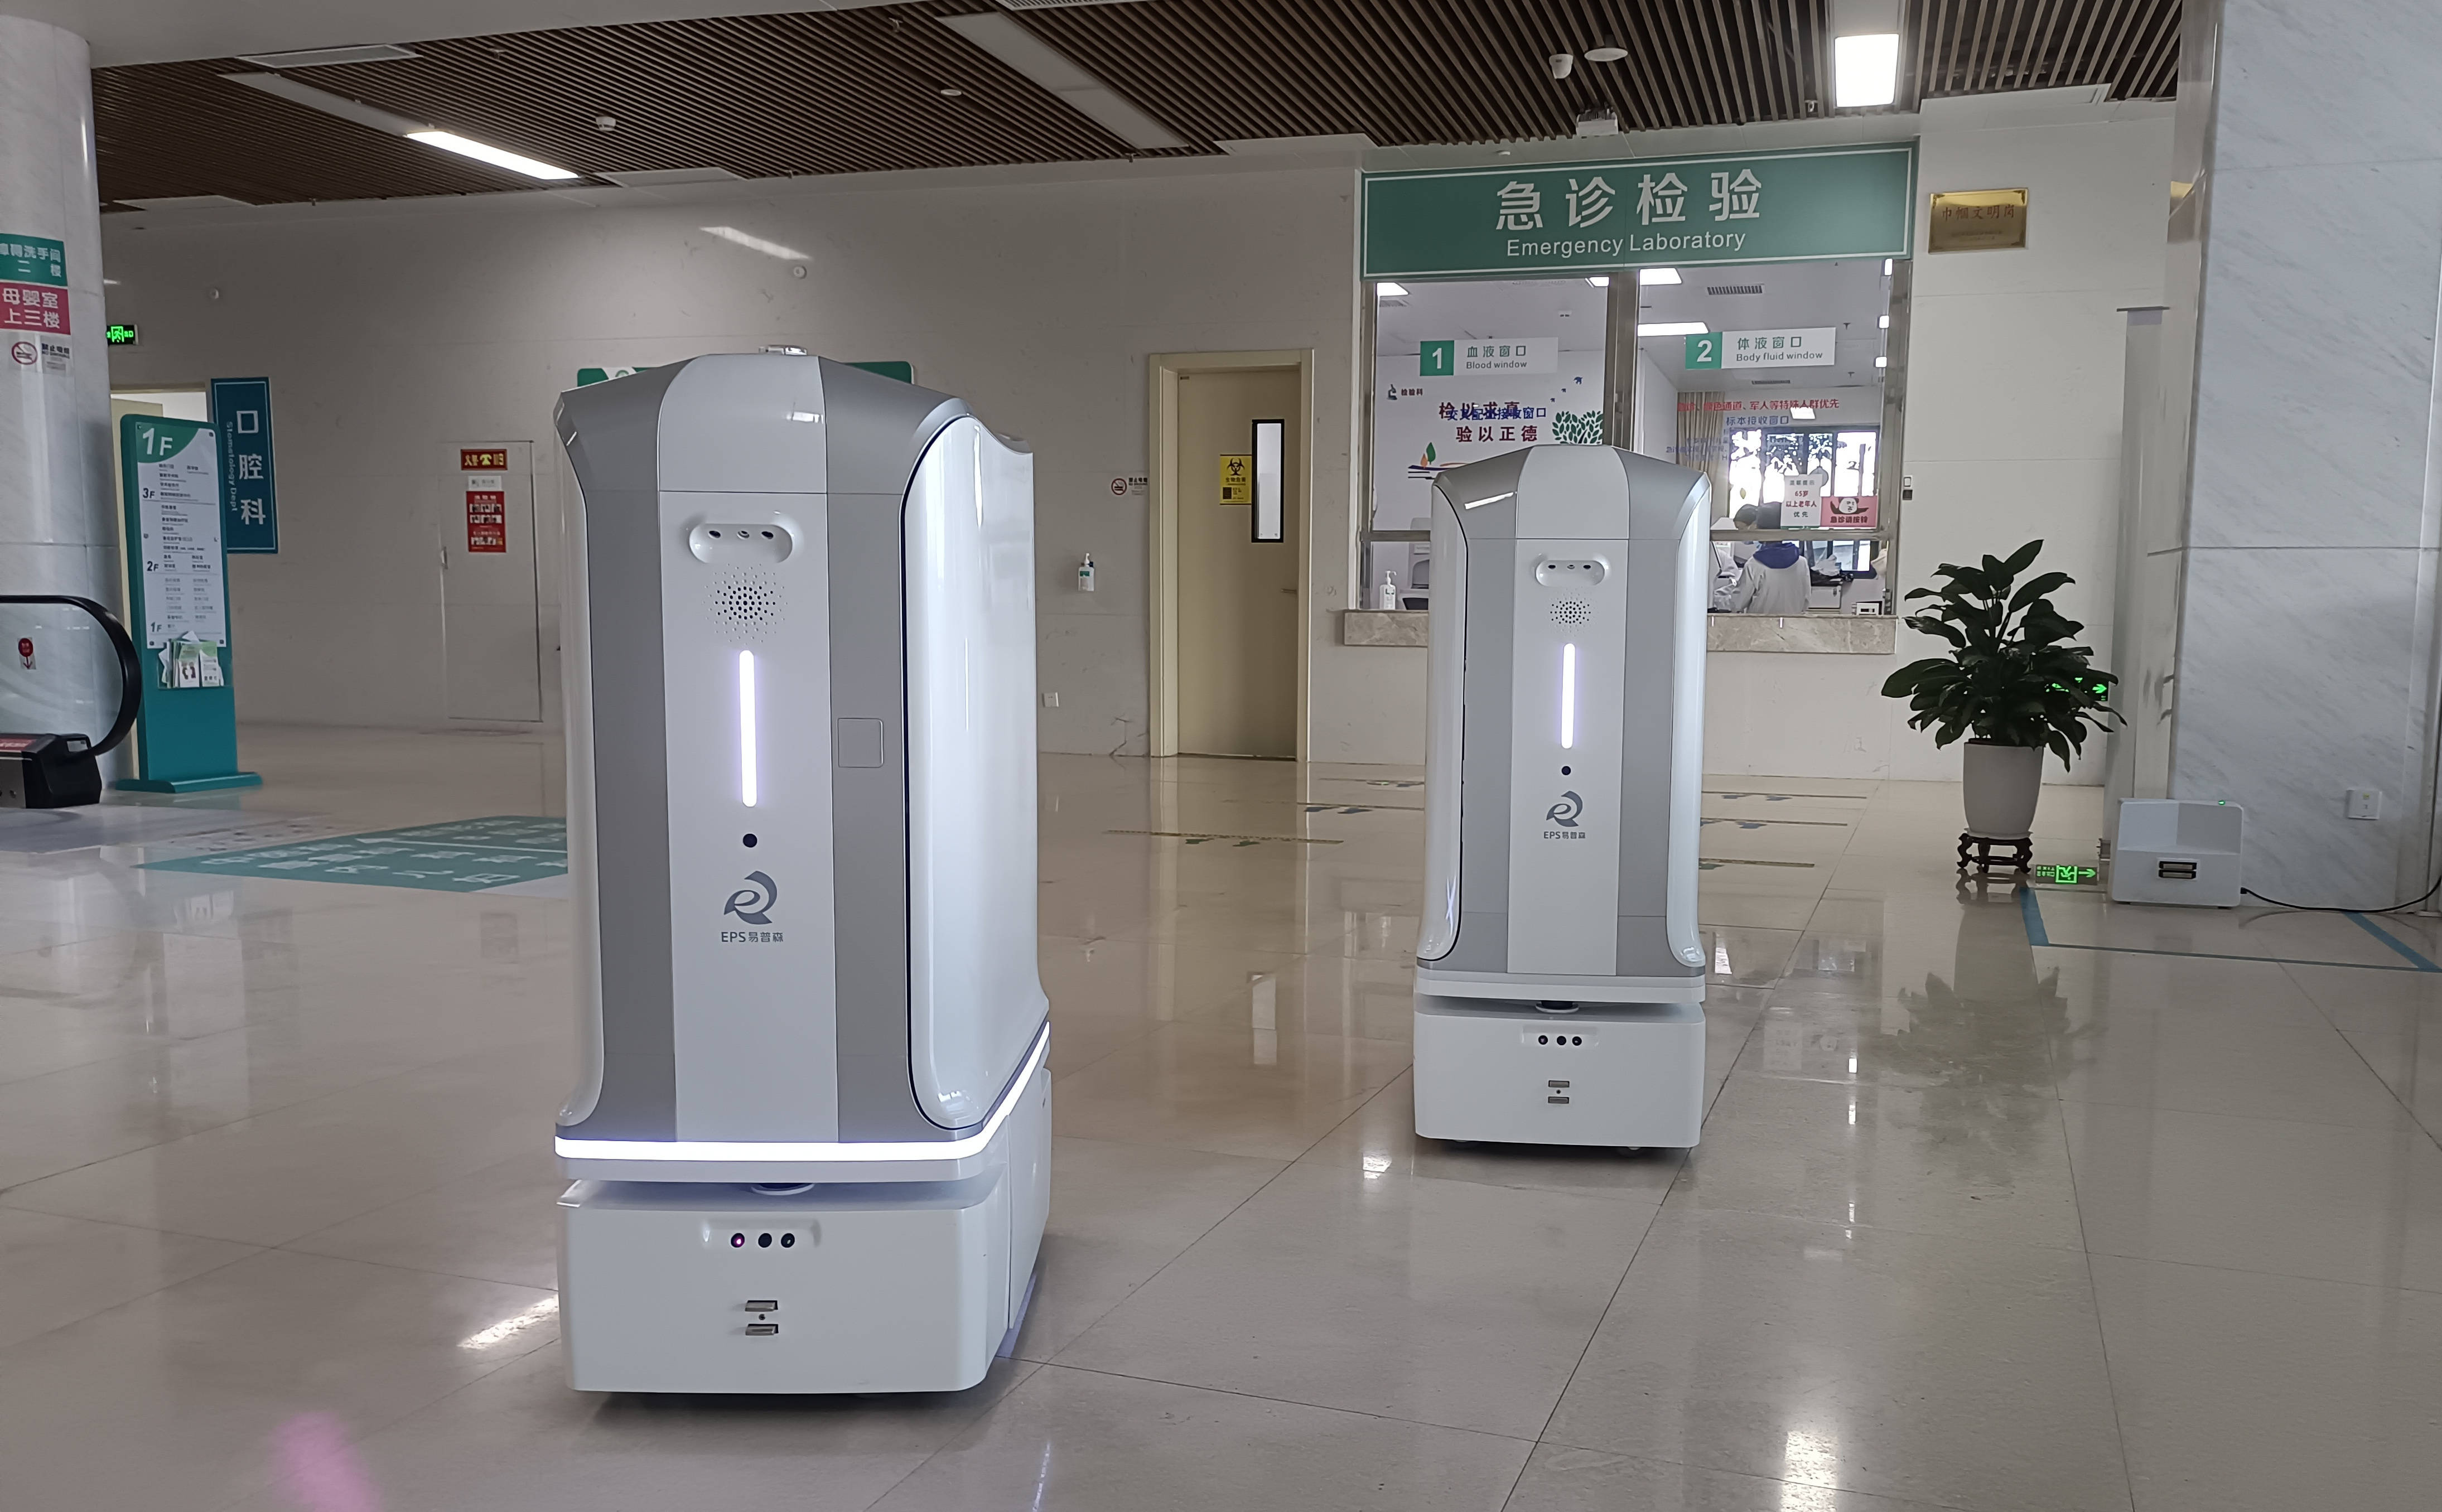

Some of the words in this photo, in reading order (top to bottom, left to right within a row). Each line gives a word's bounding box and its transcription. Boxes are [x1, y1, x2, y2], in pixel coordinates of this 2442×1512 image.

[1495, 168, 1762, 230] 急诊检验
[1507, 238, 1623, 258] Emergency
[1629, 232, 1746, 252] Laboratory
[2, 288, 59, 308] 母婴室
[4, 308, 60, 329] 上三楼
[1467, 345, 1527, 358] 血液窗口
[1696, 340, 1712, 362] 2
[1737, 336, 1802, 350] 体液窗口
[1432, 347, 1442, 369] 1
[1494, 360, 1527, 369] window
[1736, 353, 1761, 363] Body
[1763, 352, 1784, 361] fluid
[1787, 351, 1823, 360] window
[1456, 425, 1538, 442] 验以正德
[237, 410, 266, 524] 口腔科
